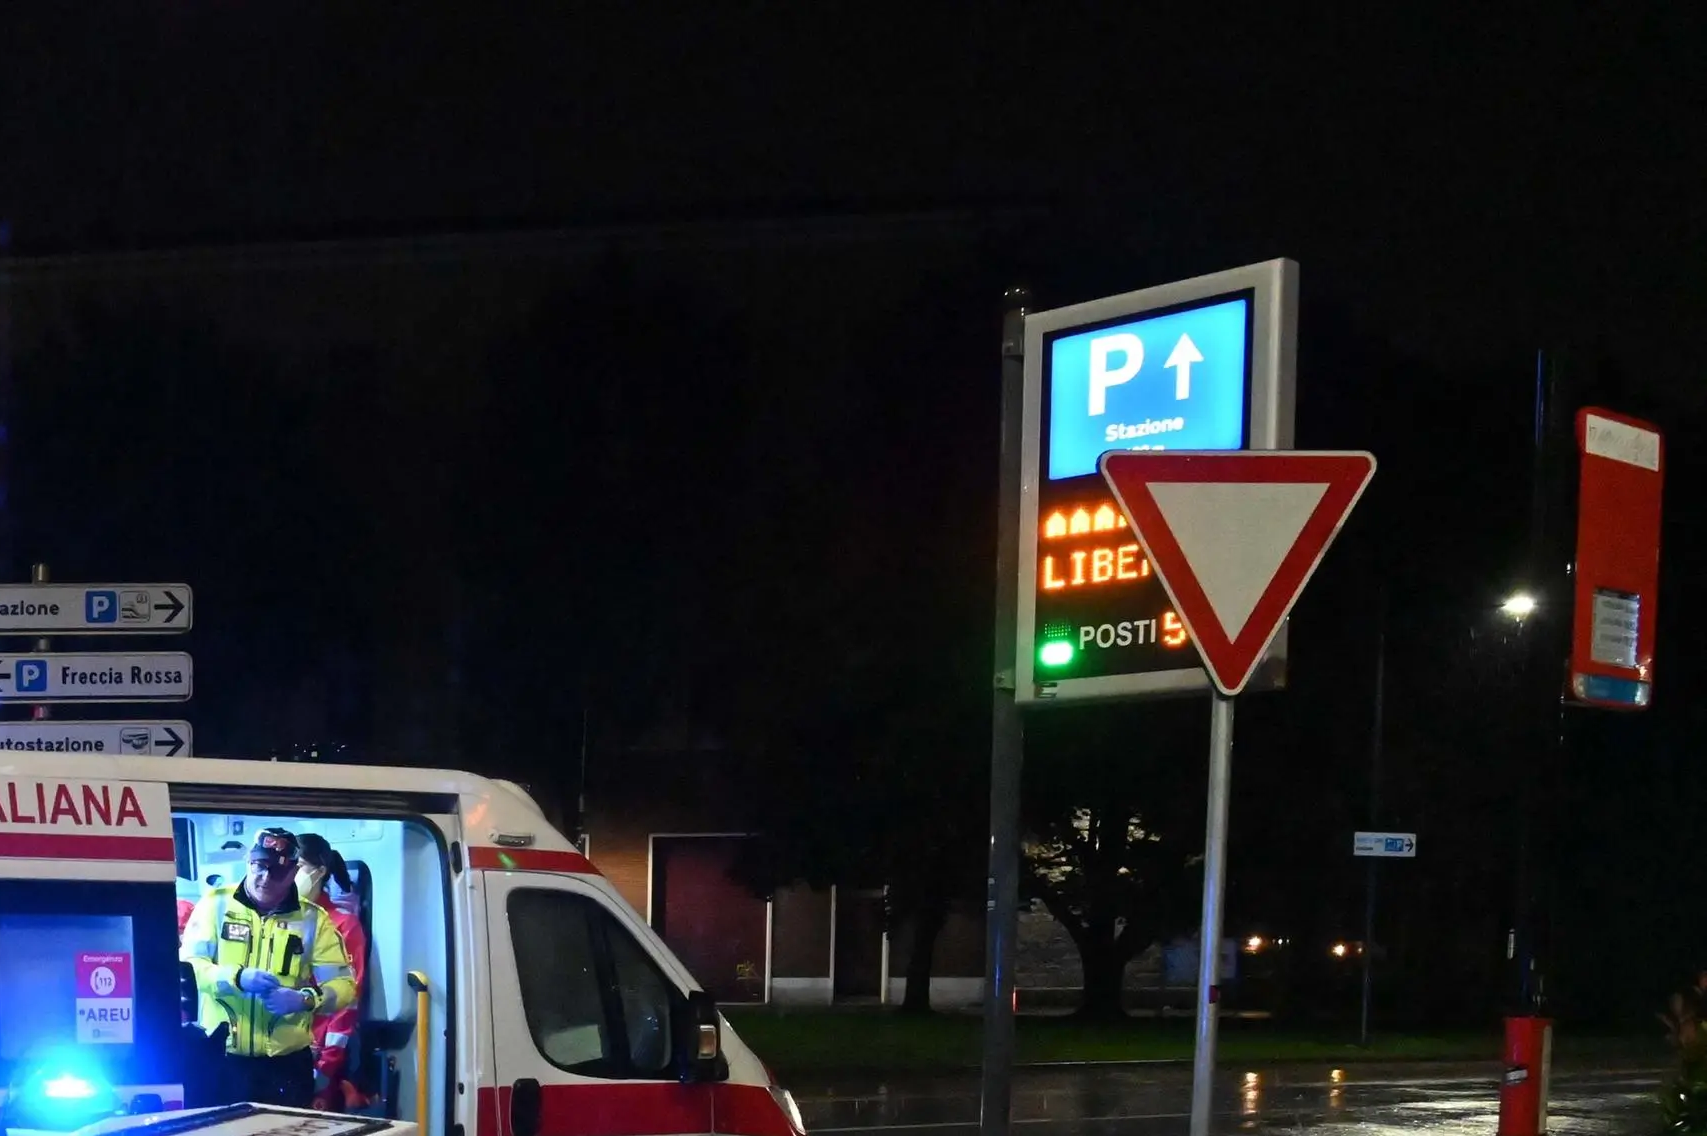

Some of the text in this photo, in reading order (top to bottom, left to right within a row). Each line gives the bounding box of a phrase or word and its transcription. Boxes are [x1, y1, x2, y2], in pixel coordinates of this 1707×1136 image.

[1088, 332, 1145, 416] P
[1105, 416, 1184, 441] Stazione
[93, 595, 110, 618] P
[1080, 619, 1156, 650] POSTI
[22, 664, 183, 687] P Freccia Rossa
[86, 1008, 131, 1021] AREU
